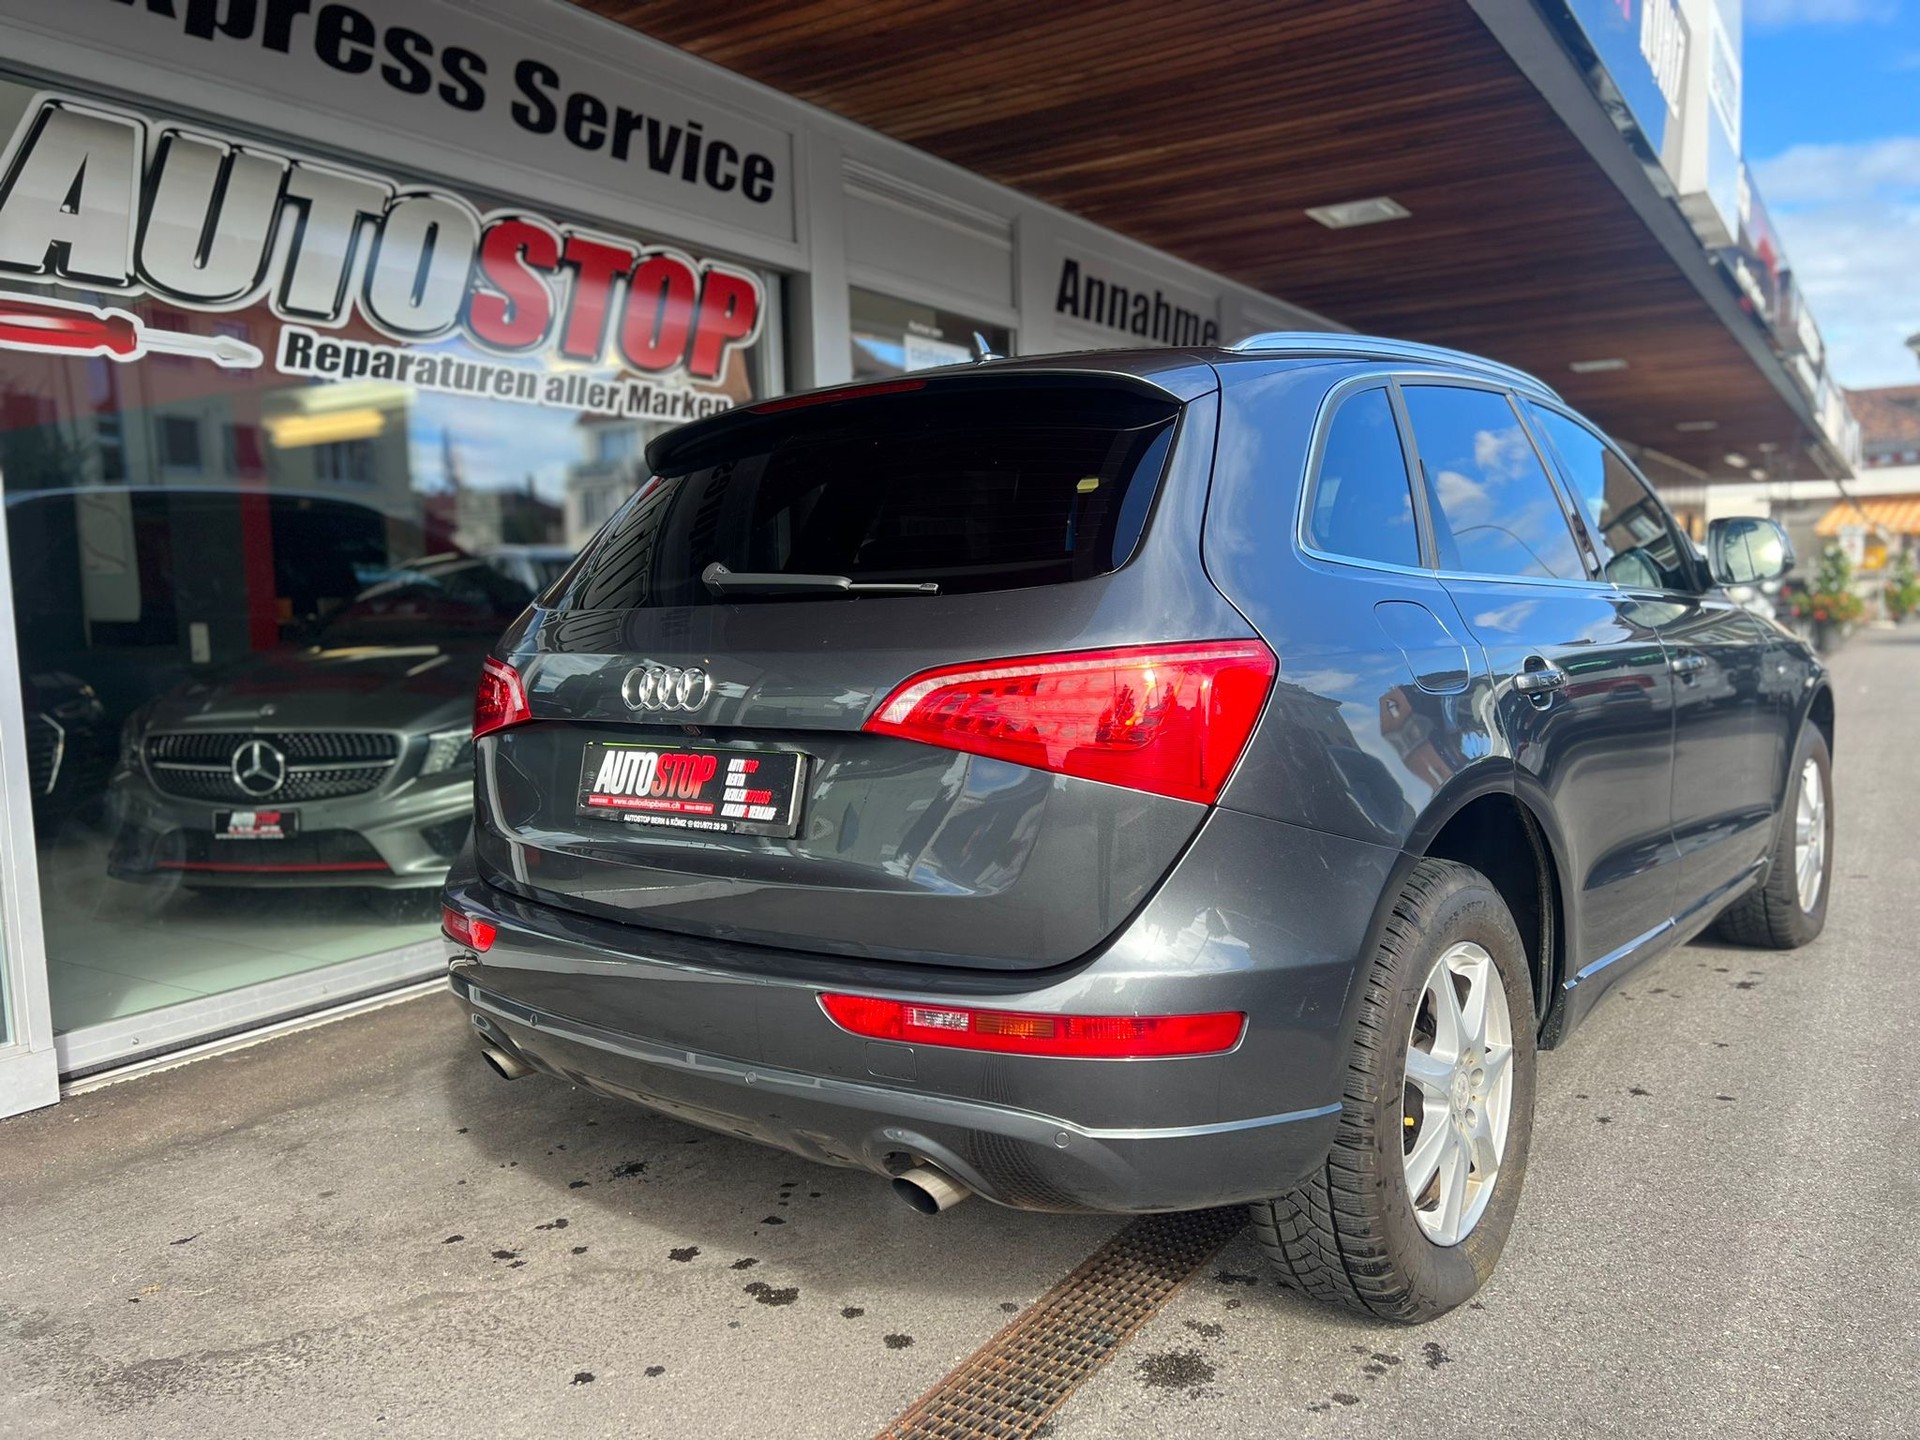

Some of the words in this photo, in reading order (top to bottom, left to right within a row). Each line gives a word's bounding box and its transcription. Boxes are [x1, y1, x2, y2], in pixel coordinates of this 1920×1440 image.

[113, 0, 487, 114] press
[511, 58, 776, 205] Service
[0, 97, 760, 380] AUTOSTOP
[1055, 256, 1220, 347] Annahme
[284, 331, 537, 399] Reparaturen
[544, 373, 621, 410] aller
[627, 383, 730, 418] Marken
[593, 750, 718, 799] AUTOSTOP
[624, 814, 651, 824] AUTOSTOP
